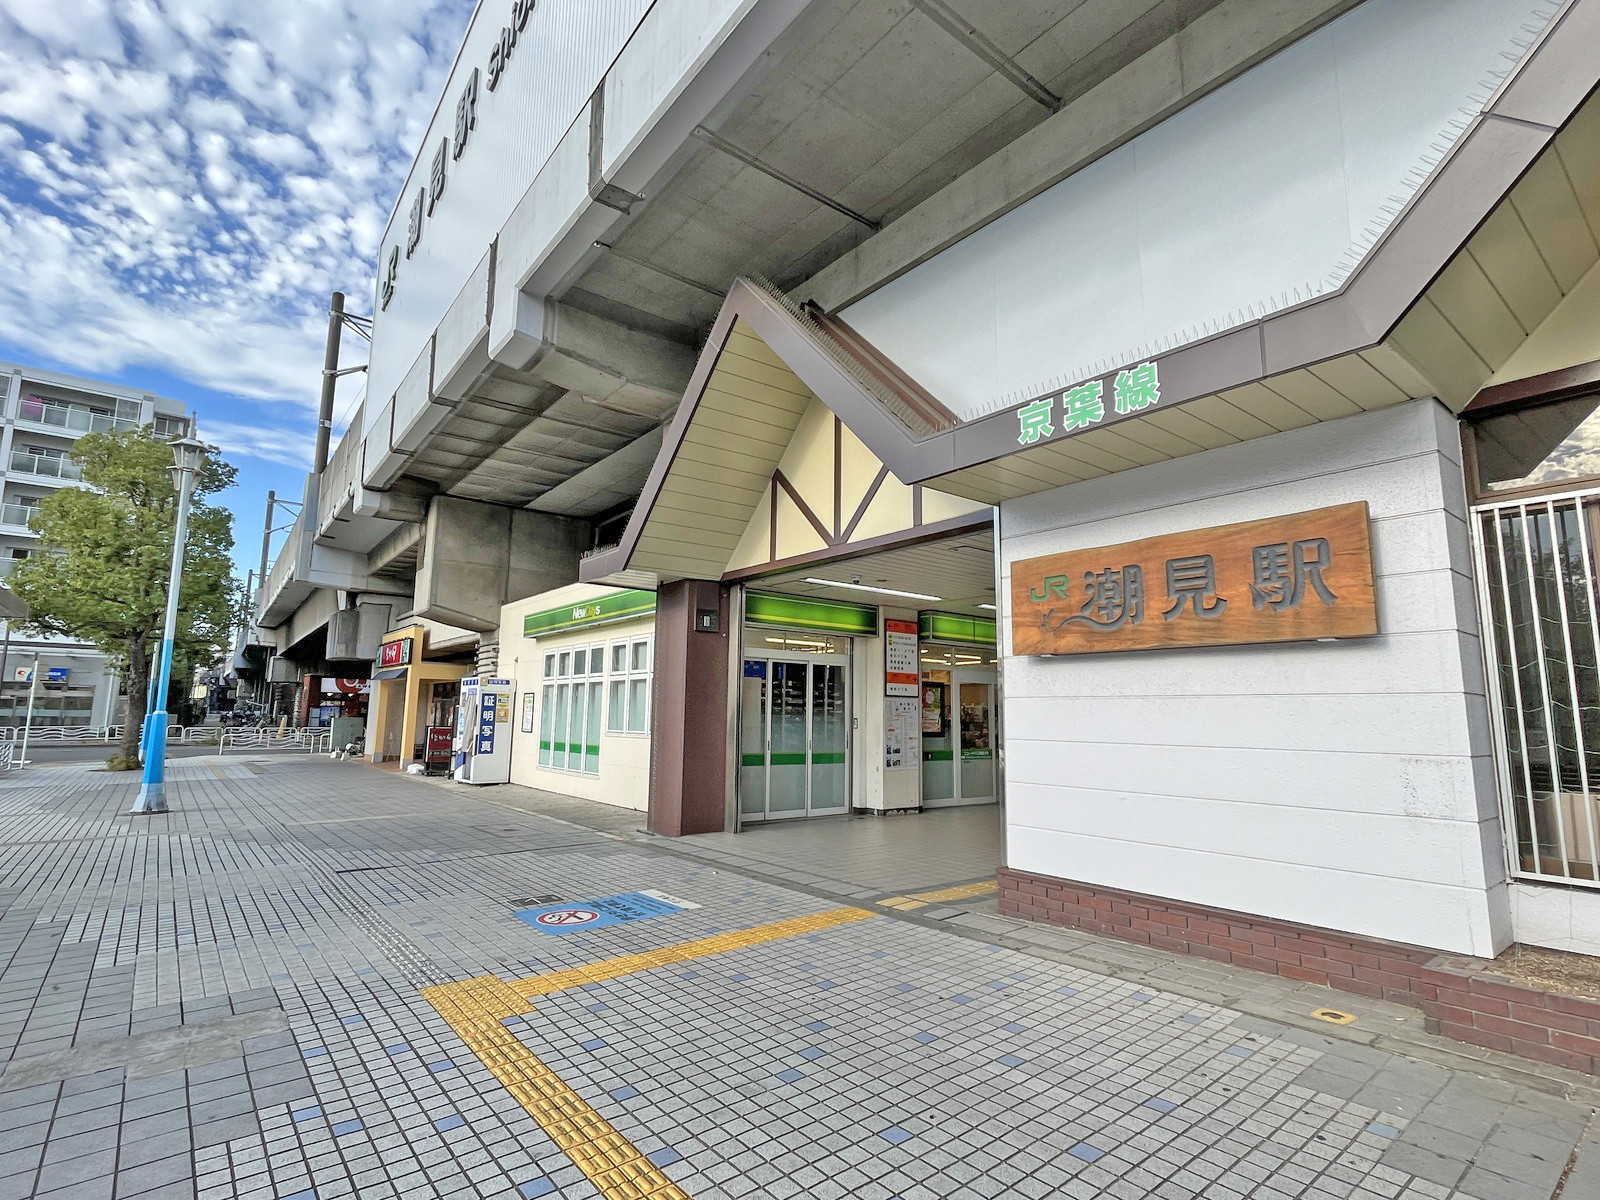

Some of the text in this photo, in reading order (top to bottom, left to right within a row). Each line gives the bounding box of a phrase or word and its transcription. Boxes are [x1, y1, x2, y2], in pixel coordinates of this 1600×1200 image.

[405, 66, 480, 260] 潮見駅
[486, 0, 536, 92] Shio
[1016, 361, 1162, 446] 京葉線
[1029, 537, 1338, 632] JR 潮見駅
[480, 695, 495, 752] 証明写真
